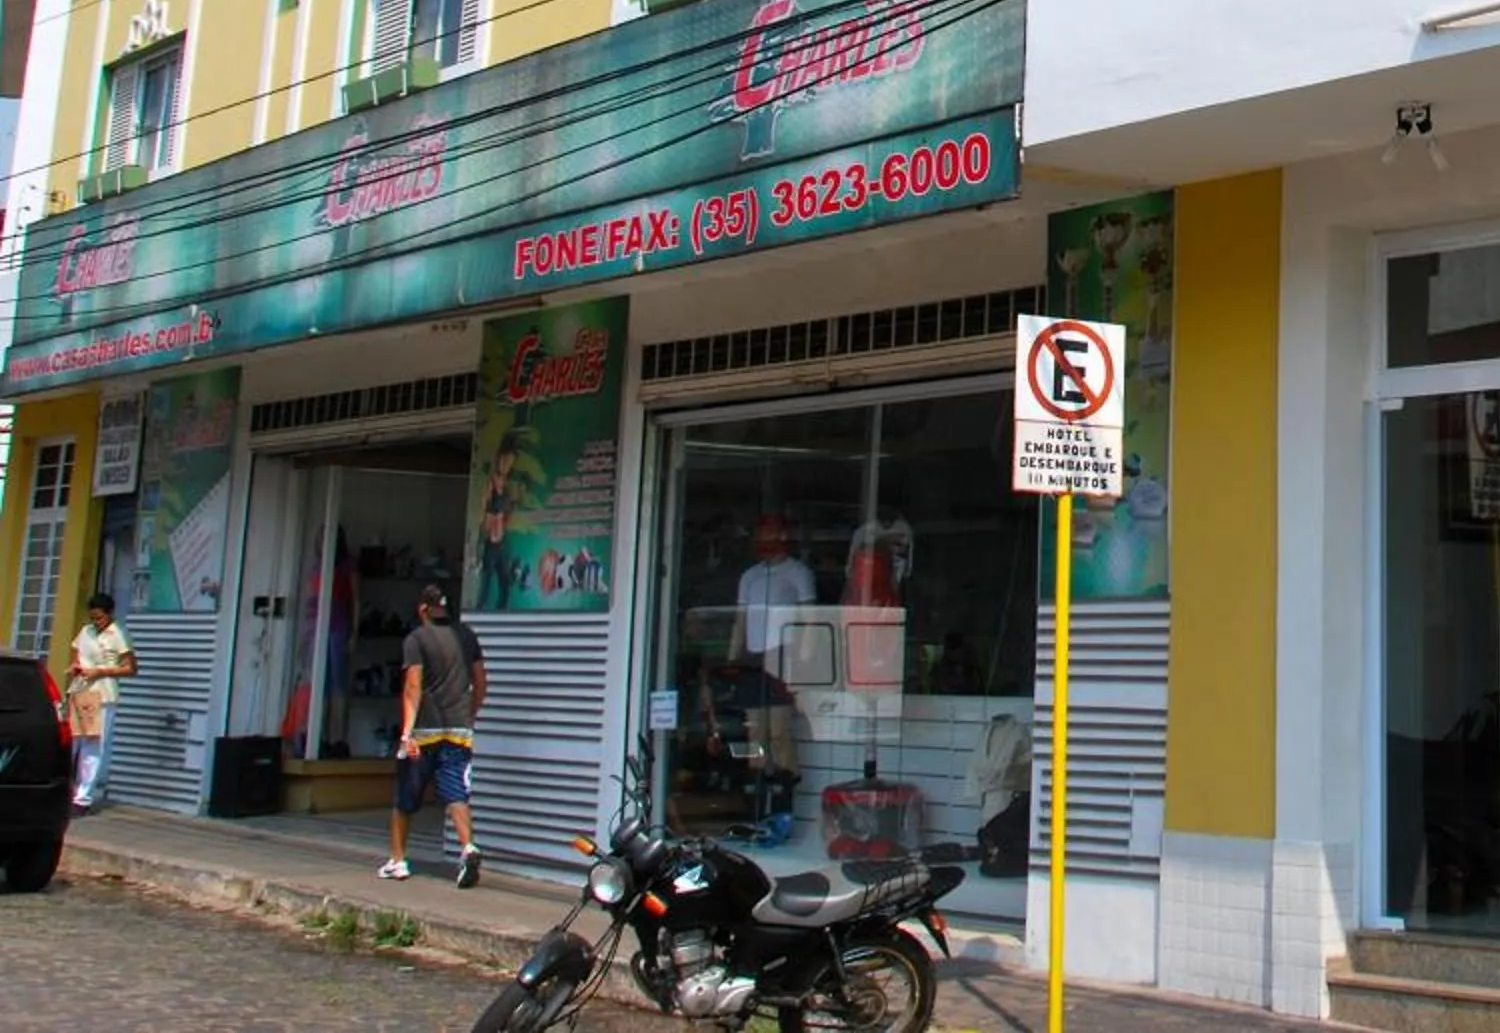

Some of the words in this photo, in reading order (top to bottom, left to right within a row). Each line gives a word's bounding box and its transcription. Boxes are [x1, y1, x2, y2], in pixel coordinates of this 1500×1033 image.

[690, 188, 759, 255] (35)
[771, 132, 992, 226] 3623-6000
[1047, 428, 1092, 442] HOTEL
[1024, 440, 1097, 458] EMBARQUE
[1105, 447, 1113, 459] E
[1019, 456, 1117, 474] DESEMBARQUE
[1048, 474, 1108, 490] MINUTOS
